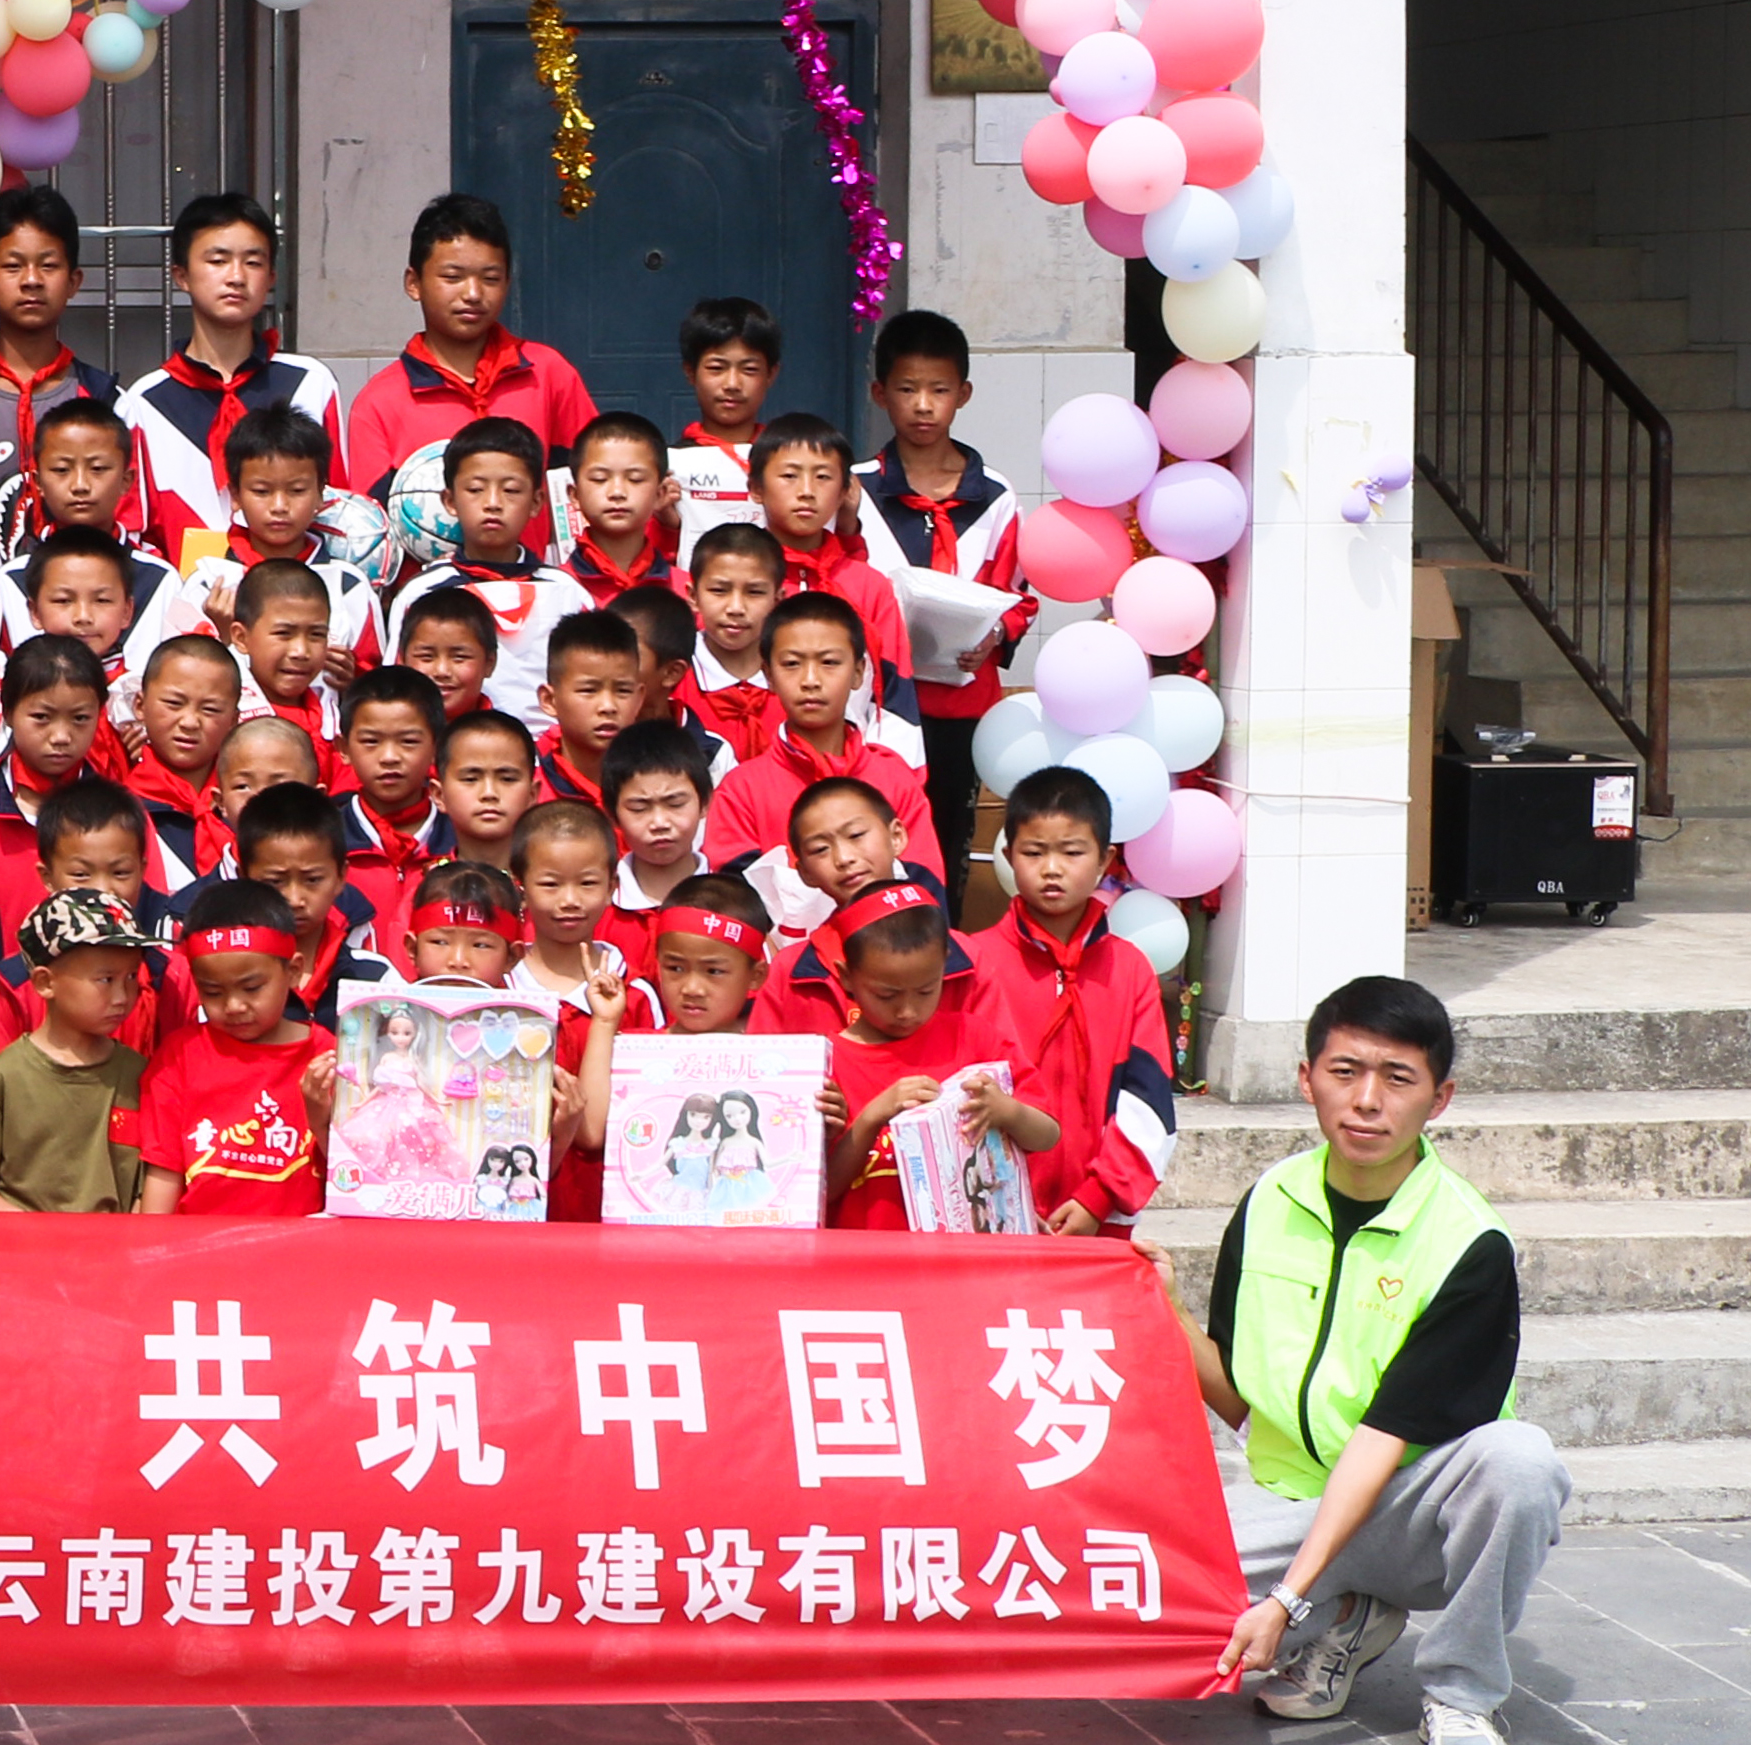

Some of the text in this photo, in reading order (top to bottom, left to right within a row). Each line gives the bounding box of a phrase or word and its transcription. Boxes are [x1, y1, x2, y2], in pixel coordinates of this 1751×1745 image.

[690, 473, 720, 488] KM
[882, 886, 922, 908] 中国
[1537, 880, 1564, 894] QBA
[703, 913, 743, 942] 中国
[205, 928, 250, 950] 中国
[138, 1298, 1125, 1492] 共筑中国梦
